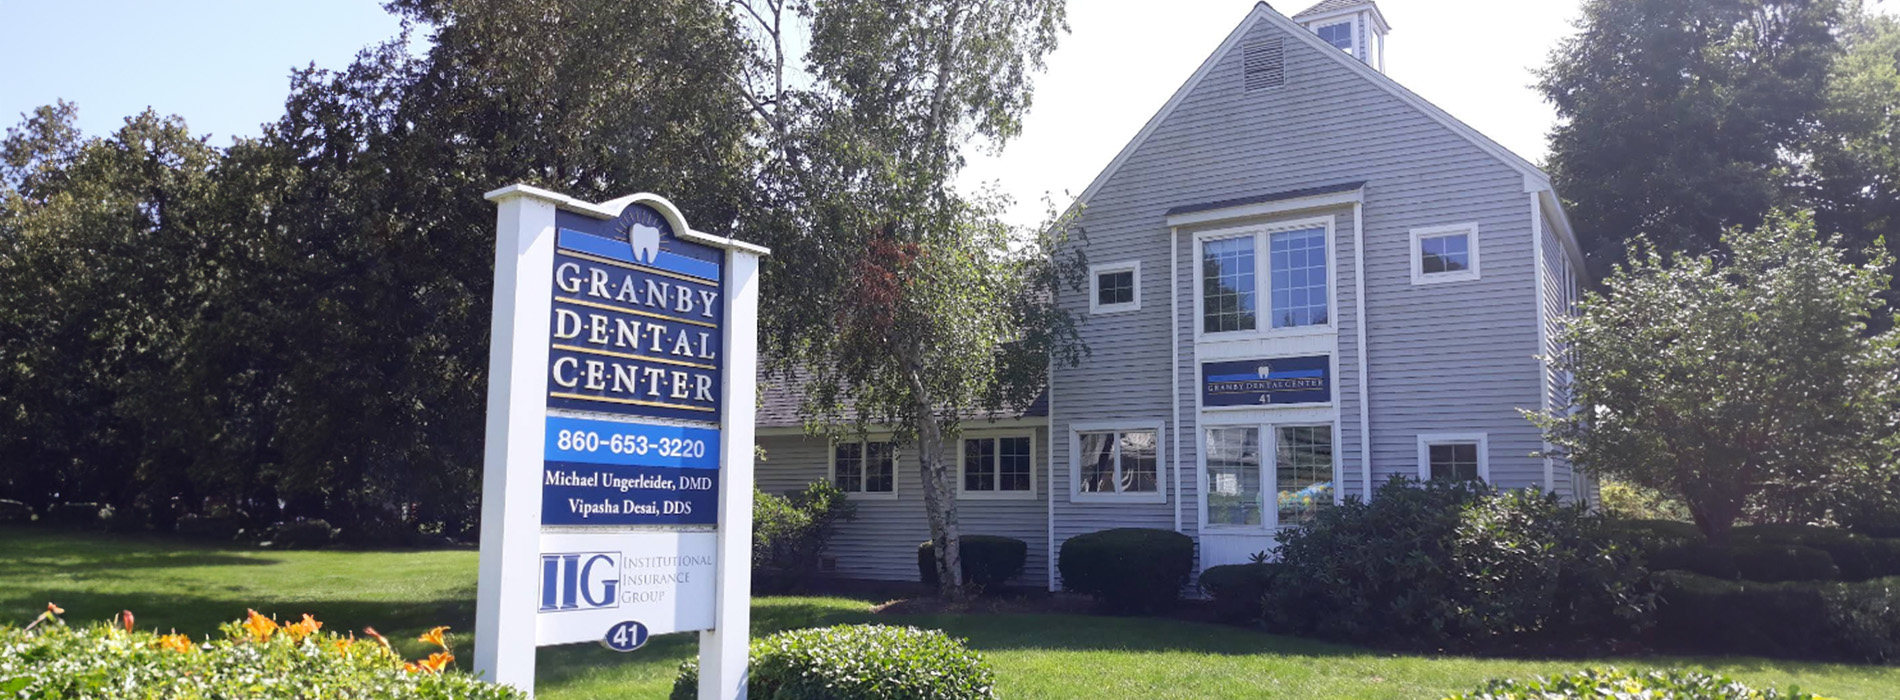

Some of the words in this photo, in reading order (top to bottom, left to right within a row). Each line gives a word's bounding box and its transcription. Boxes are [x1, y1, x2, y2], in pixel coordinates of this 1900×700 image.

[1208, 383, 1243, 391] GRANBY
[1246, 382, 1282, 390] DENTAL
[1284, 379, 1323, 388] CENTER
[1258, 394, 1271, 403] 41
[557, 429, 705, 458] 860-653-3220
[545, 470, 598, 487] Michael
[602, 473, 676, 492] Ungerleider,
[679, 476, 712, 490] DMD
[568, 498, 619, 517] Vipasha
[623, 499, 660, 516] Desai,
[663, 501, 692, 514] DDS
[540, 554, 619, 610] IIG
[613, 624, 638, 646] 41
